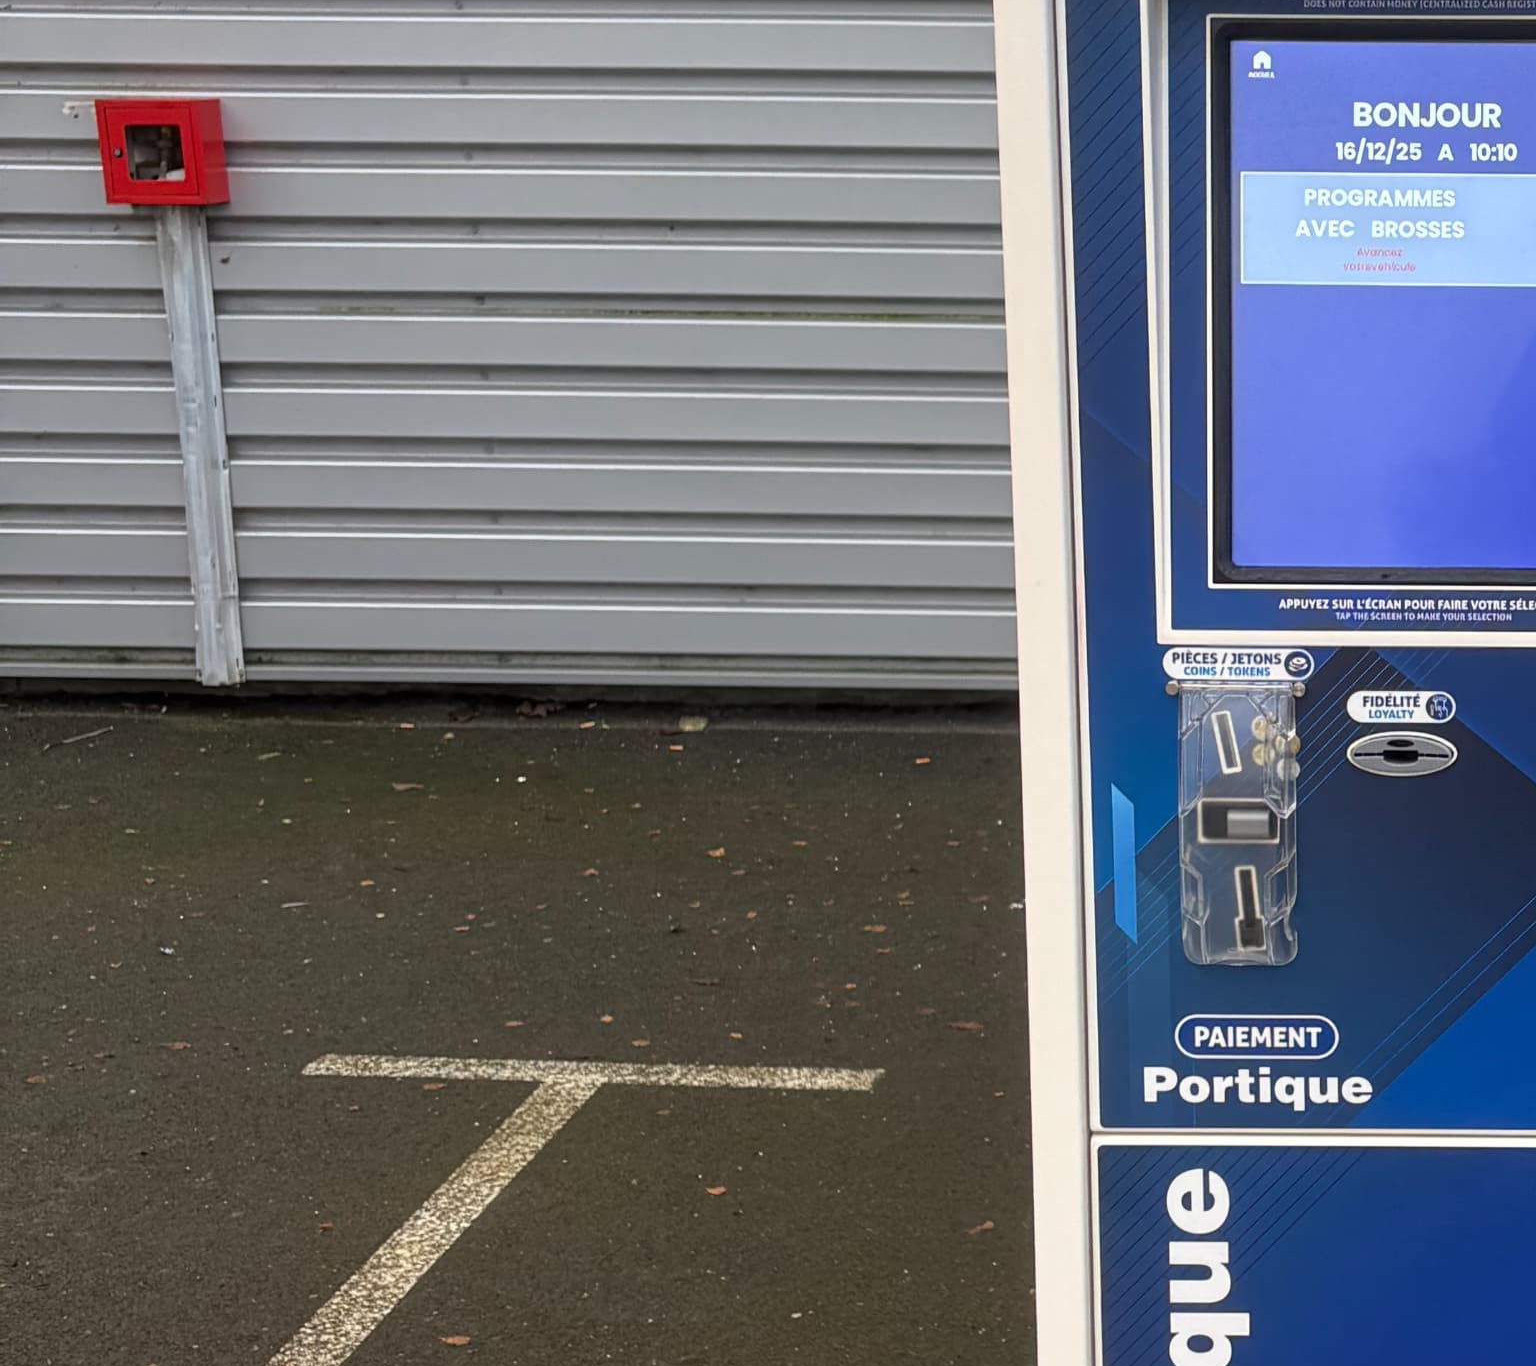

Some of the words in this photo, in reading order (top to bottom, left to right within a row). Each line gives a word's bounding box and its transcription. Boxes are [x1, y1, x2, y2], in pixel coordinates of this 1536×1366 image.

[1352, 101, 1502, 128] BONJOUR
[1336, 137, 1422, 165] 16/12/25
[1438, 143, 1454, 162] A
[1470, 143, 1518, 162] 10:10
[1304, 188, 1456, 208] PROGRAMMES
[1295, 220, 1356, 239] AVEC
[1371, 220, 1465, 239] BROSSES
[1278, 599, 1329, 610] APPUYEZ
[1332, 599, 1354, 610] SUR
[1356, 597, 1402, 610] L'ÉCRAN
[1404, 599, 1436, 610] POUR
[1438, 599, 1468, 610] FAIRE
[1471, 599, 1507, 610] VOTRE
[1335, 612, 1352, 621] TAP
[1353, 612, 1369, 621] THE
[1370, 612, 1402, 621] SCREEN
[1404, 612, 1415, 621] TO
[1417, 612, 1440, 621] MAKE
[1442, 612, 1466, 621] YOUR
[1468, 612, 1512, 621] SELECTION
[1172, 650, 1218, 666] PIÈCES
[1221, 652, 1227, 666] /
[1230, 652, 1282, 666] JETONS
[1184, 667, 1218, 677] COINS
[1220, 667, 1224, 677] /
[1228, 667, 1270, 677] TOKENS
[1362, 694, 1420, 708] FIDÉLITÉ
[1368, 709, 1414, 719] LOYALTY
[1194, 1026, 1322, 1048] PAIEMENT
[1143, 1066, 1374, 1111] Portique
